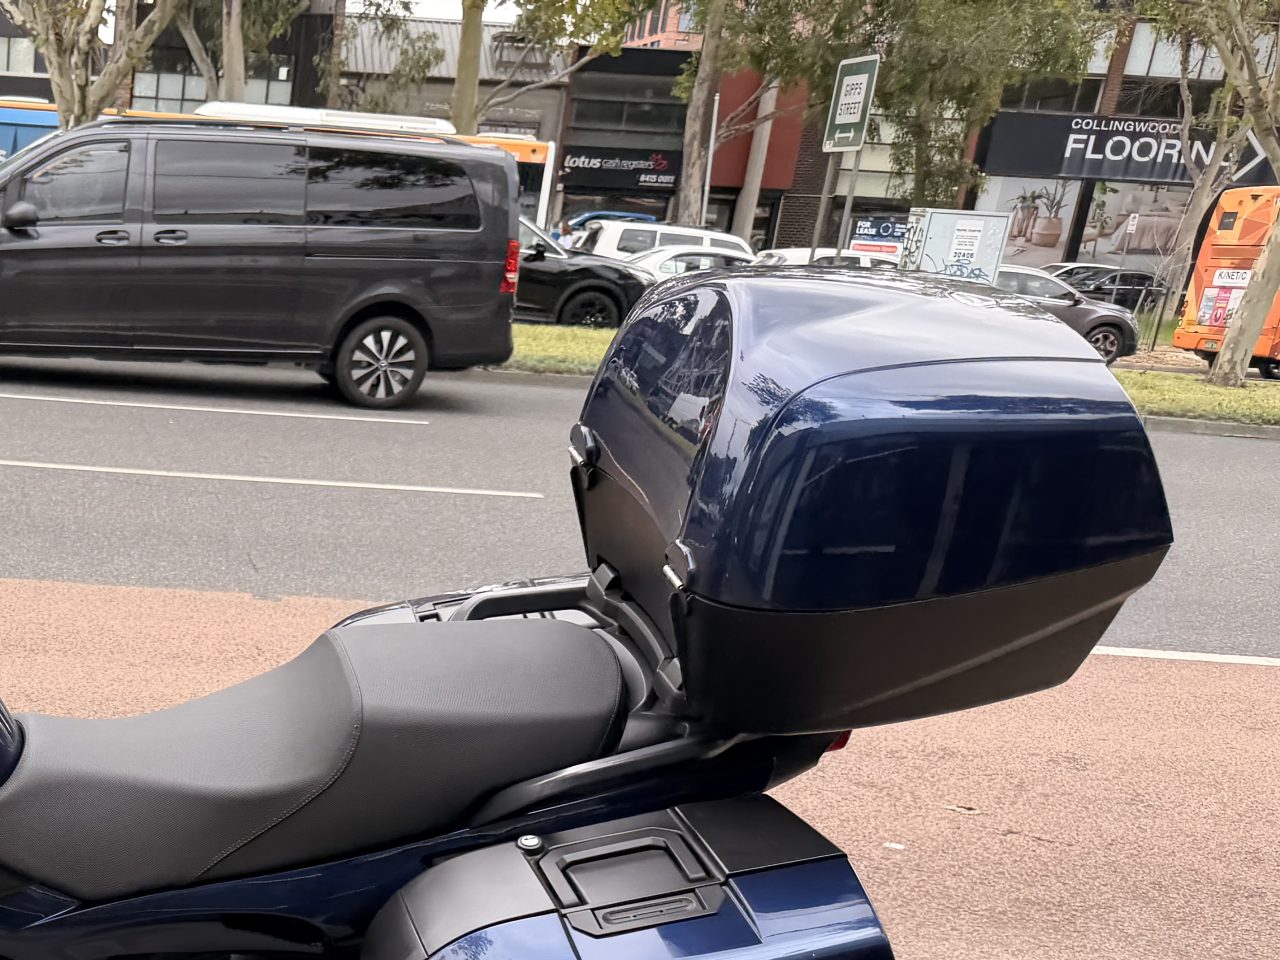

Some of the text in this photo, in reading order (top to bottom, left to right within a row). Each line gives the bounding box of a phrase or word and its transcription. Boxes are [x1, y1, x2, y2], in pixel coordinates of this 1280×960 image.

[844, 82, 863, 96] GIPPS
[838, 101, 861, 116] STREET
[1071, 118, 1181, 134] COLLINGWOOD
[1064, 133, 1230, 167] FLOORN
[564, 154, 602, 168] lotus
[856, 227, 877, 235] LEASE
